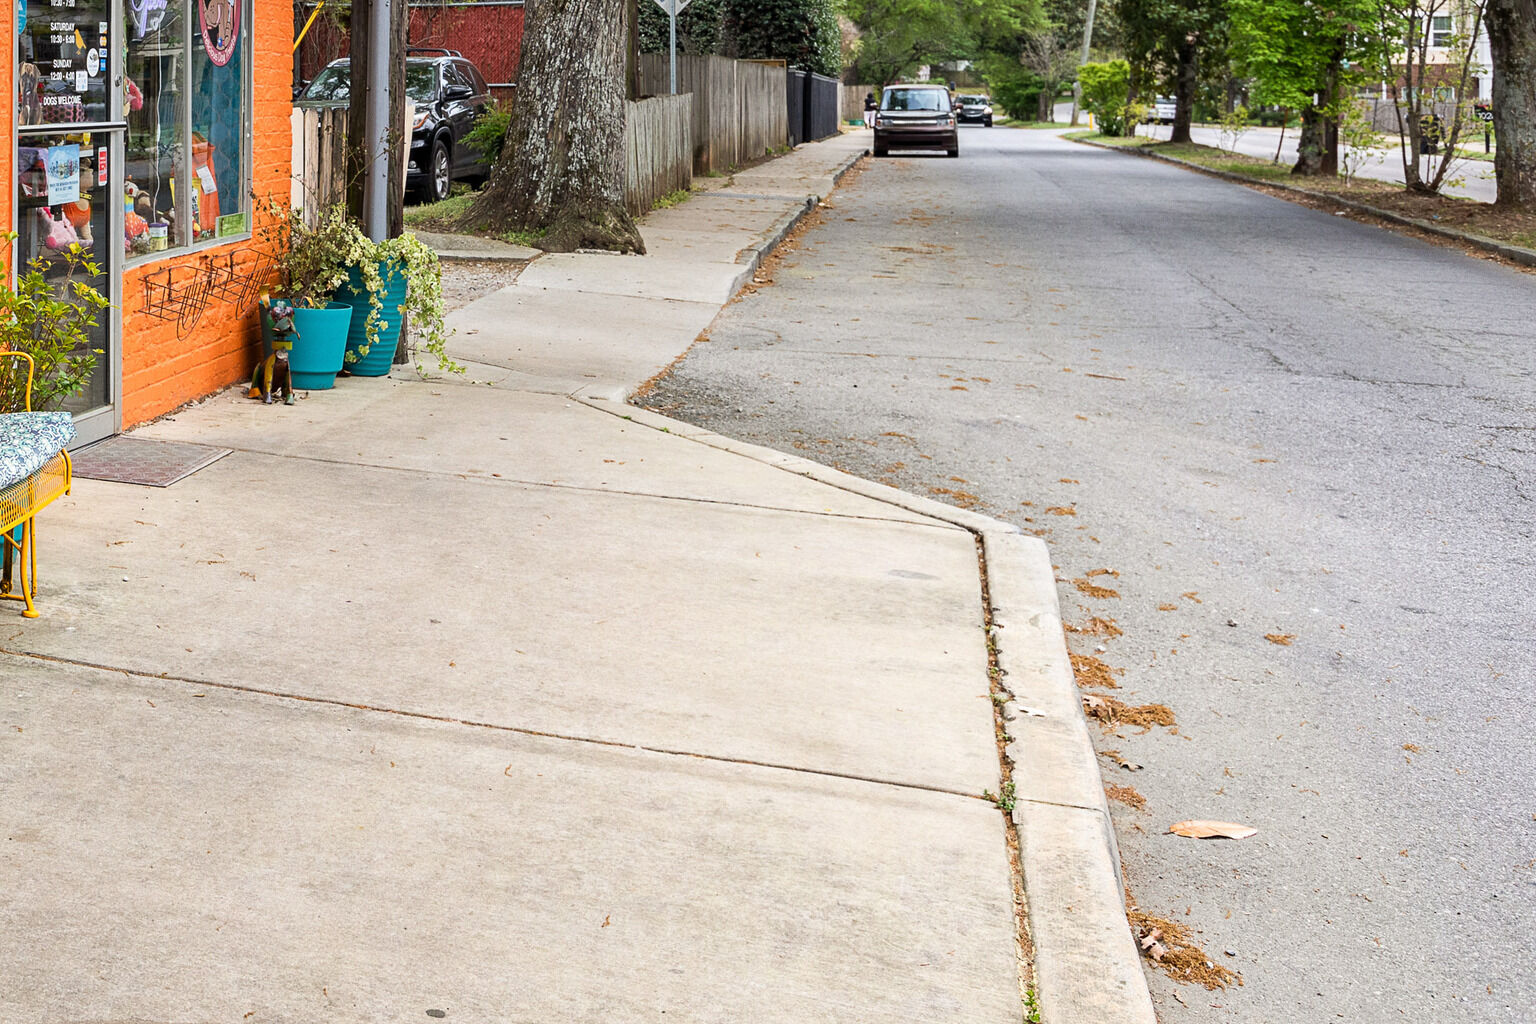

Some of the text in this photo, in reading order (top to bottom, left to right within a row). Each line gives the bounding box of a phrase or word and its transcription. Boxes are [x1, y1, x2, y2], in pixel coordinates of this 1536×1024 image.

[50, 22, 75, 32] SATURDAY
[53, 59, 73, 69] SUNDAY
[43, 94, 82, 106] DOGS WELCOME
